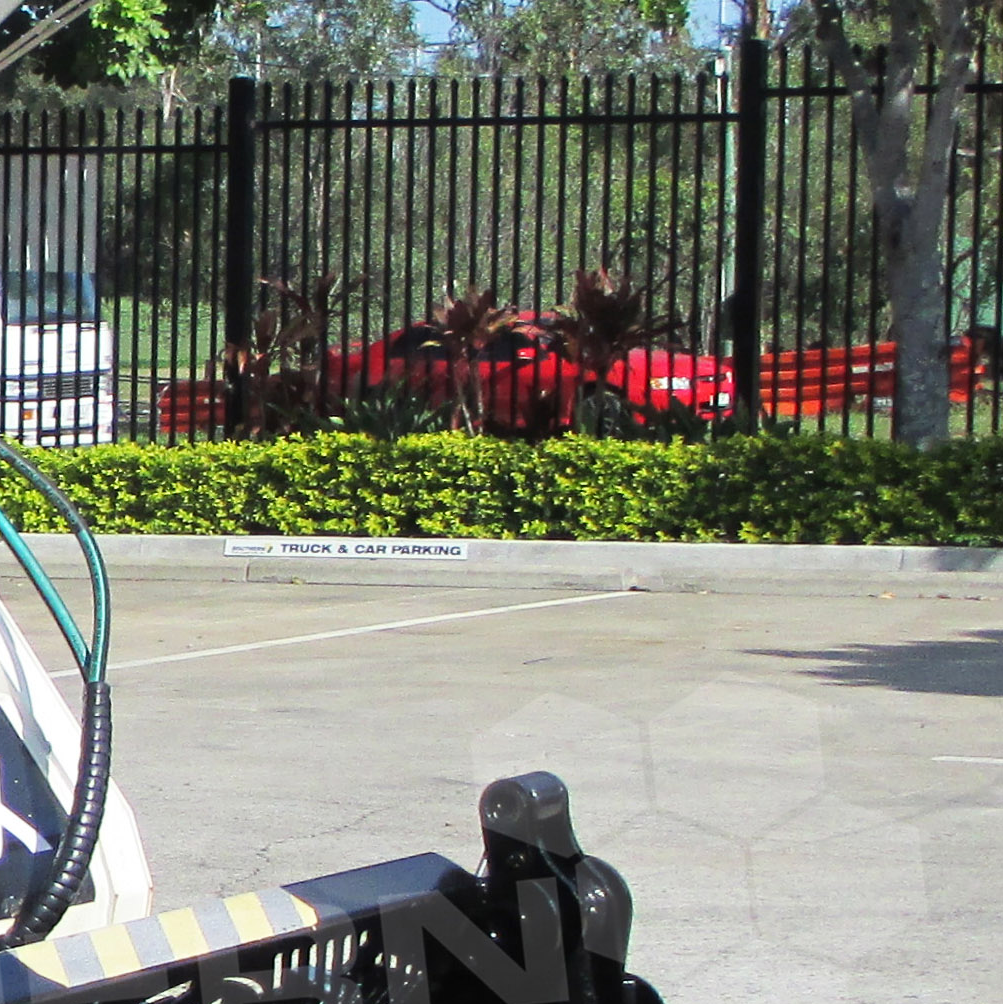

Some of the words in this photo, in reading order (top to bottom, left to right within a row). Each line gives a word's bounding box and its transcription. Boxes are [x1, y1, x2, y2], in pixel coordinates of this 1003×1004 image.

[280, 543, 332, 554] TRUCK
[337, 544, 349, 554] &
[354, 544, 386, 555] CAR
[391, 545, 462, 556] PARKING
